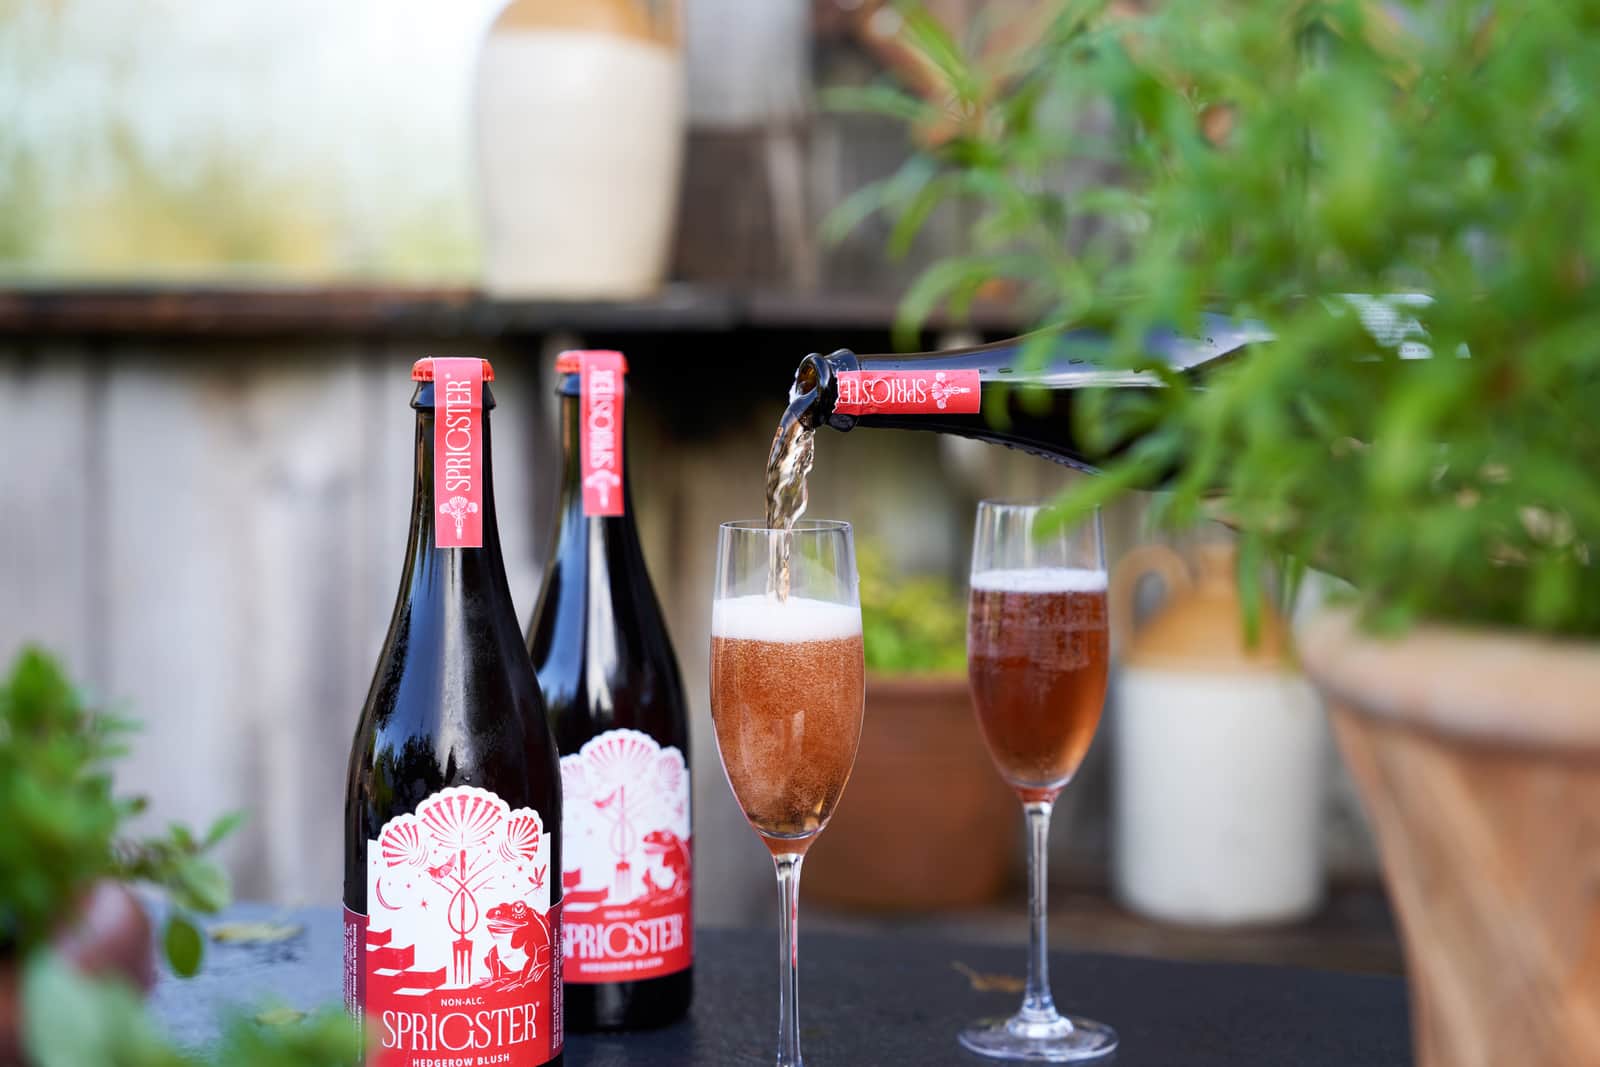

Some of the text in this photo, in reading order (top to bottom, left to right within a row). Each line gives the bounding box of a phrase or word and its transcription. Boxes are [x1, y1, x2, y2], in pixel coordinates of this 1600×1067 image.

[445, 380, 472, 492] SPRIGSTER
[440, 996, 485, 1007] NON-ALC.
[382, 1003, 537, 1051] SPRIGSTER
[412, 1053, 510, 1067] HEDGEROW BLUSH
